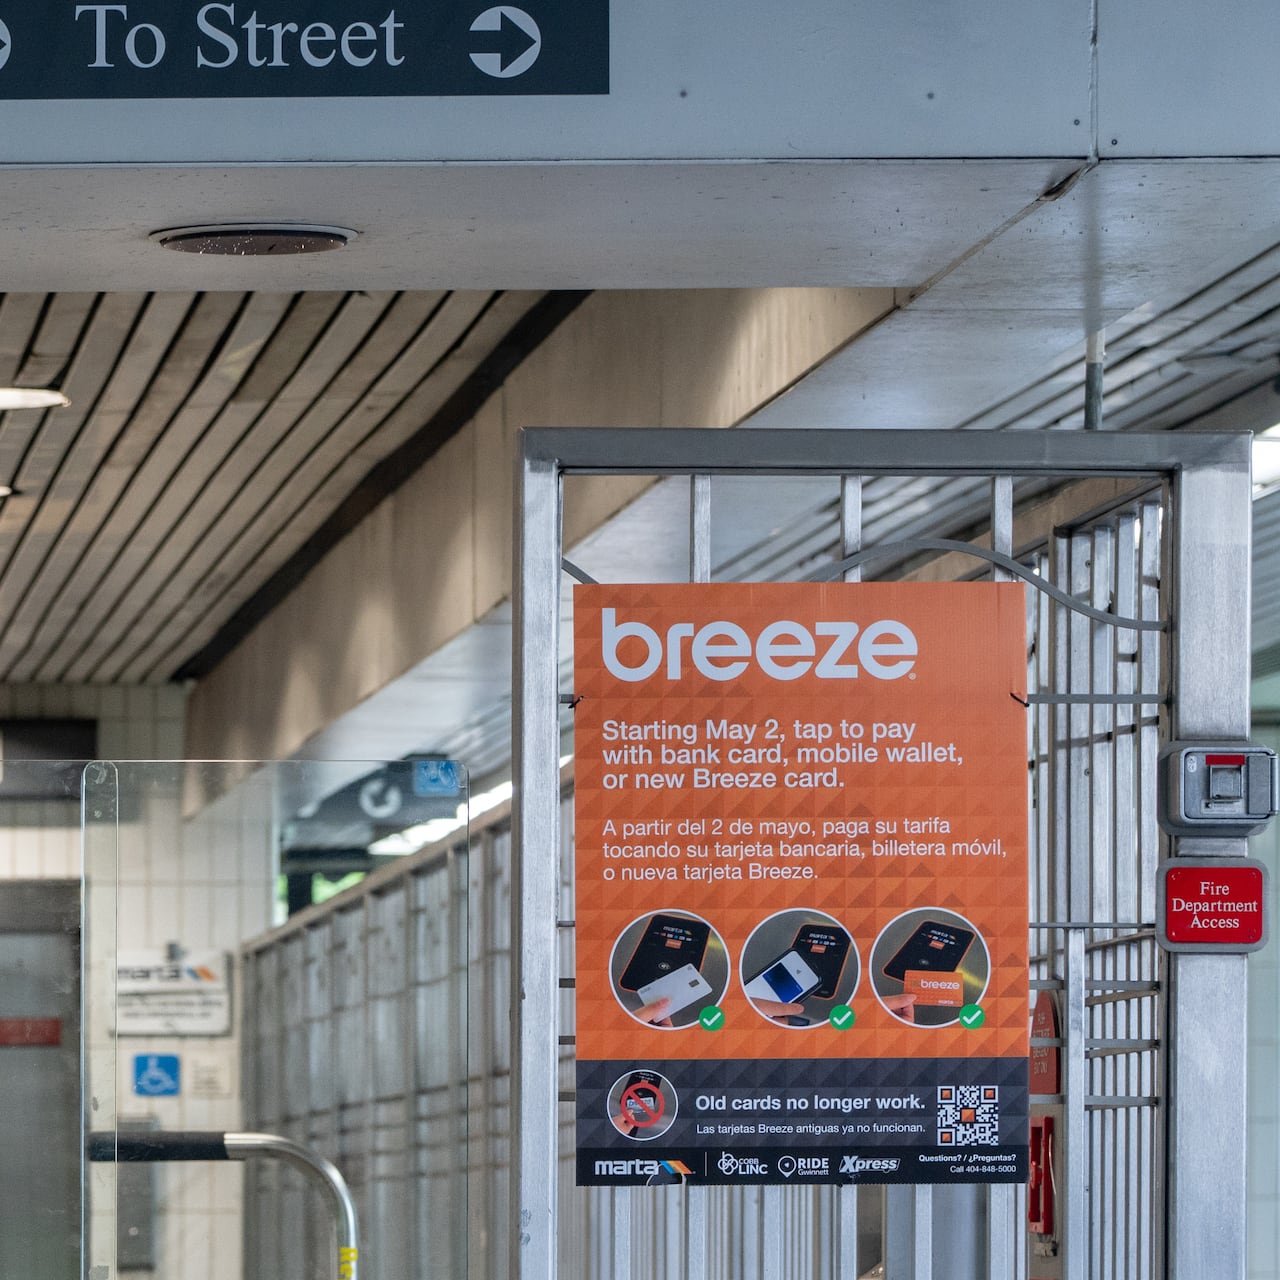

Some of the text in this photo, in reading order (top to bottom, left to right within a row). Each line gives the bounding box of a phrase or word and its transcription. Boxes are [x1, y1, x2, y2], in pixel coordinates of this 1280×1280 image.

[75, 3, 405, 68] To Street
[602, 608, 918, 682] breeze
[603, 719, 915, 744] Starting May 2, tap to pay
[603, 741, 962, 767] with bank card, mobile wallet,
[603, 767, 844, 789] or new Breeze card.
[603, 817, 950, 839] A partir del 2 de mayo, paga su tarifa
[603, 839, 1006, 861] tocando su tarjeta bancaria, billetera móvil,
[602, 863, 817, 883] o nueva tarjeta Breeze.
[1199, 881, 1230, 896] Fire
[1173, 898, 1257, 914] Department
[1191, 914, 1239, 928] Access
[920, 979, 960, 990] breeze
[696, 1094, 925, 1112] Old cards no longer work.
[696, 1122, 926, 1136] Las tarjetas Breeze antiguas ya no funcionan.
[738, 1157, 760, 1165] COBB
[797, 1157, 830, 1169] RIDE
[840, 1156, 898, 1173] Xpress
[918, 1153, 962, 1162] Questions?
[967, 1153, 1017, 1163] ¿Preguntas?
[595, 1159, 659, 1176] marta
[738, 1163, 768, 1175] LINC
[797, 1167, 829, 1176] Gwinnett
[949, 1164, 1017, 1174] Call 404-848-5000
